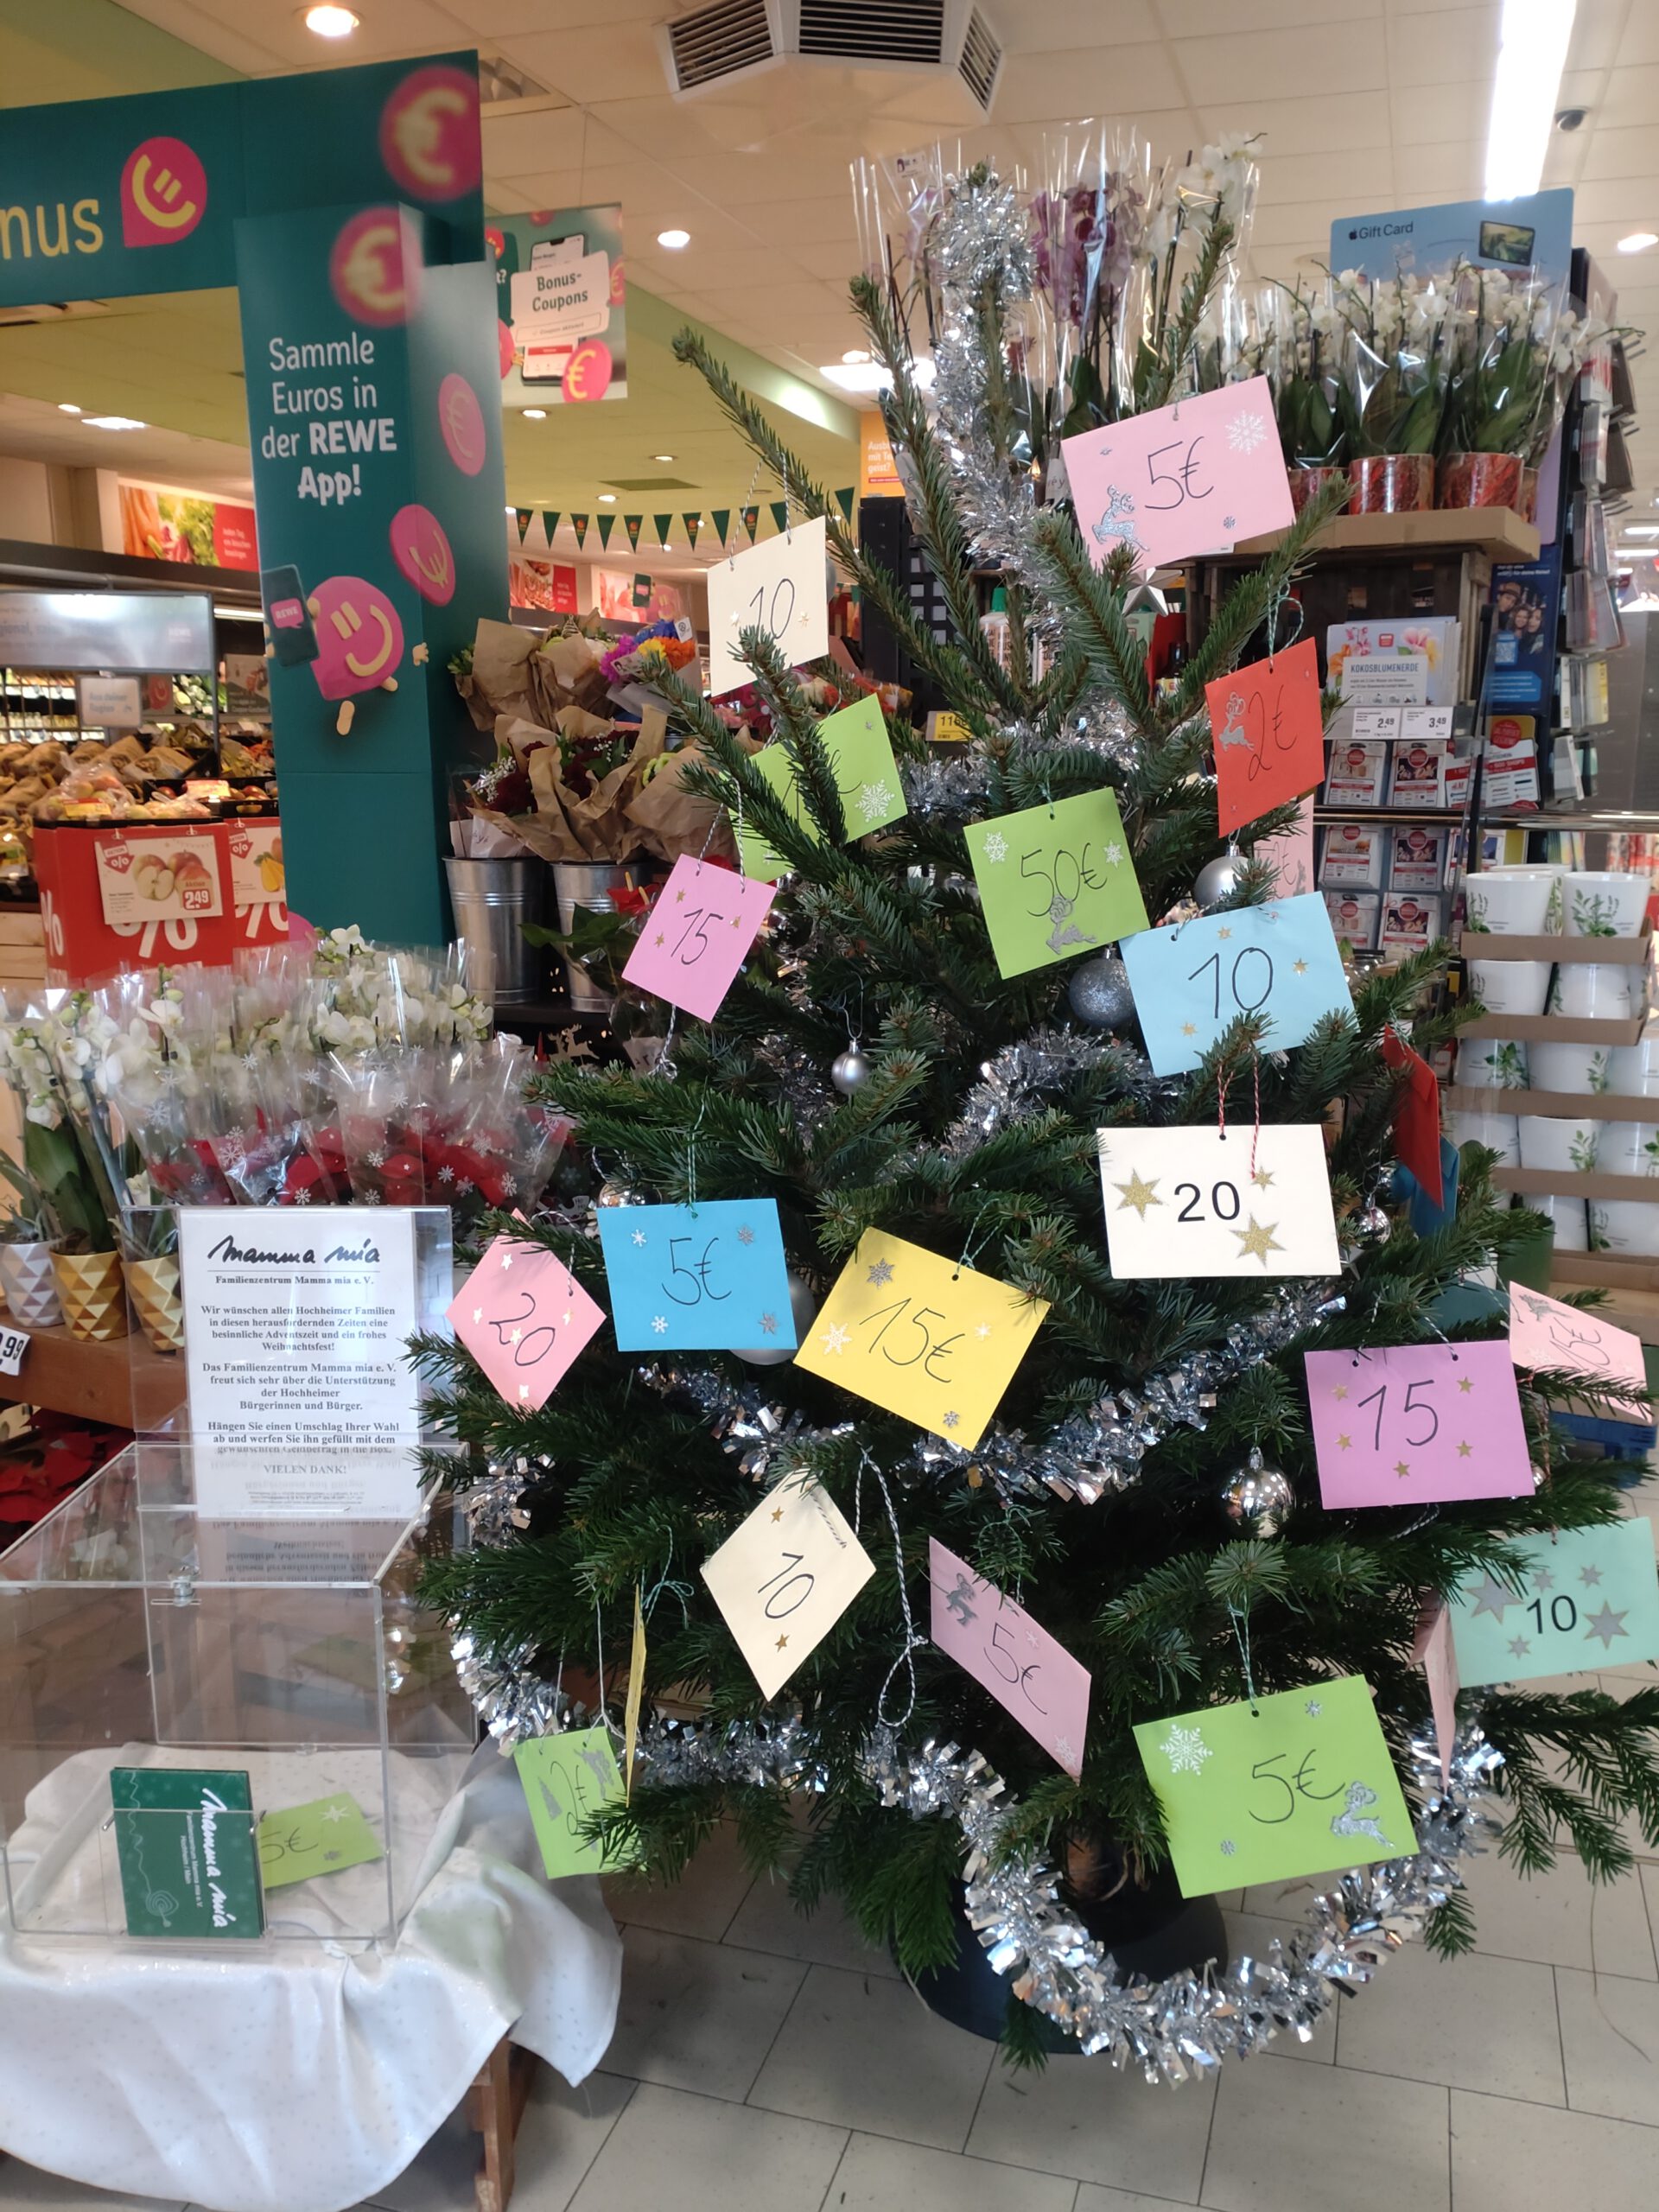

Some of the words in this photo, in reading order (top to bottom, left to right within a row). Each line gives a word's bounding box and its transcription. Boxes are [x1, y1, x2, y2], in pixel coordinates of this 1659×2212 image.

[1359, 226, 1382, 239] Gift
[1383, 220, 1414, 236] Card
[537, 272, 582, 292] Bonus-
[532, 290, 588, 312] Coupons
[269, 331, 375, 372] Sammle
[272, 381, 344, 415] Euros
[353, 375, 378, 409] in
[261, 425, 301, 459] der
[308, 417, 397, 455] REWE
[1145, 436, 1214, 510] 5€
[297, 463, 361, 506] App!
[276, 607, 298, 619] REWE
[750, 578, 795, 639] 10
[1351, 663, 1420, 673] KOKOSBLUMENERDE
[1377, 718, 1395, 728] 2.49
[1428, 717, 1446, 728] 3.49
[1020, 842, 1108, 918] 50€
[185, 890, 209, 909] 2.49
[671, 908, 723, 965] 15
[1187, 947, 1274, 1020] 10
[1174, 1181, 1241, 1223] 20
[216, 1275, 292, 1285] Familienzentrum
[661, 1237, 732, 1306] 5€
[200, 1306, 221, 1315] Wir
[223, 1306, 269, 1315] wünschen
[270, 1306, 293, 1315] allen
[296, 1306, 353, 1316] Hochheimer
[355, 1306, 396, 1316] Familien
[209, 1318, 219, 1327] in
[221, 1318, 251, 1327] diesen
[337, 1319, 367, 1328] Zeiten
[369, 1319, 389, 1328] eine
[489, 1293, 556, 1366] 20
[212, 1330, 264, 1340] besinnliche
[265, 1330, 319, 1340] Adventszeit
[321, 1330, 340, 1339] und
[341, 1330, 356, 1339] ein
[358, 1330, 387, 1339] frohes
[859, 1298, 965, 1382] 15€
[262, 1342, 335, 1351] Weihnachtsfest!
[202, 1363, 221, 1372] Das
[224, 1363, 308, 1373] Familienzentrum
[311, 1363, 353, 1372] Mamma
[355, 1363, 373, 1372] mia
[387, 1363, 397, 1373] V.
[210, 1376, 234, 1385] freut
[237, 1376, 256, 1385] sich
[258, 1376, 280, 1385] sehr
[283, 1376, 305, 1385] über
[308, 1376, 322, 1385] die
[326, 1376, 397, 1387] Unterstützung
[261, 1389, 276, 1397] der
[280, 1388, 340, 1398] Hochheimer
[239, 1400, 302, 1412] Bürgerinnen
[304, 1401, 324, 1410] und
[327, 1401, 364, 1413] Bürger.
[1357, 1380, 1439, 1451] 15
[207, 1421, 245, 1433] Hängen
[248, 1421, 264, 1431] Sie
[265, 1421, 292, 1431] einen
[295, 1421, 343, 1433] Umschlag
[346, 1422, 371, 1432] Ihrer
[373, 1422, 400, 1432] Wahl
[213, 1434, 226, 1444] ab
[228, 1434, 247, 1444] und
[250, 1434, 283, 1444] werfen
[286, 1434, 301, 1444] Sie
[303, 1434, 320, 1444] ihn
[321, 1434, 353, 1446] gefüllt
[355, 1435, 372, 1445] mit
[374, 1435, 396, 1445] dem
[264, 1465, 307, 1475] VIELEN
[310, 1465, 346, 1475] DANK!
[758, 1552, 815, 1619] 10
[1527, 1595, 1578, 1634] 10
[983, 1623, 1047, 1715] 5€
[1249, 1749, 1345, 1823] 5€
[261, 1827, 319, 1864] 5€
